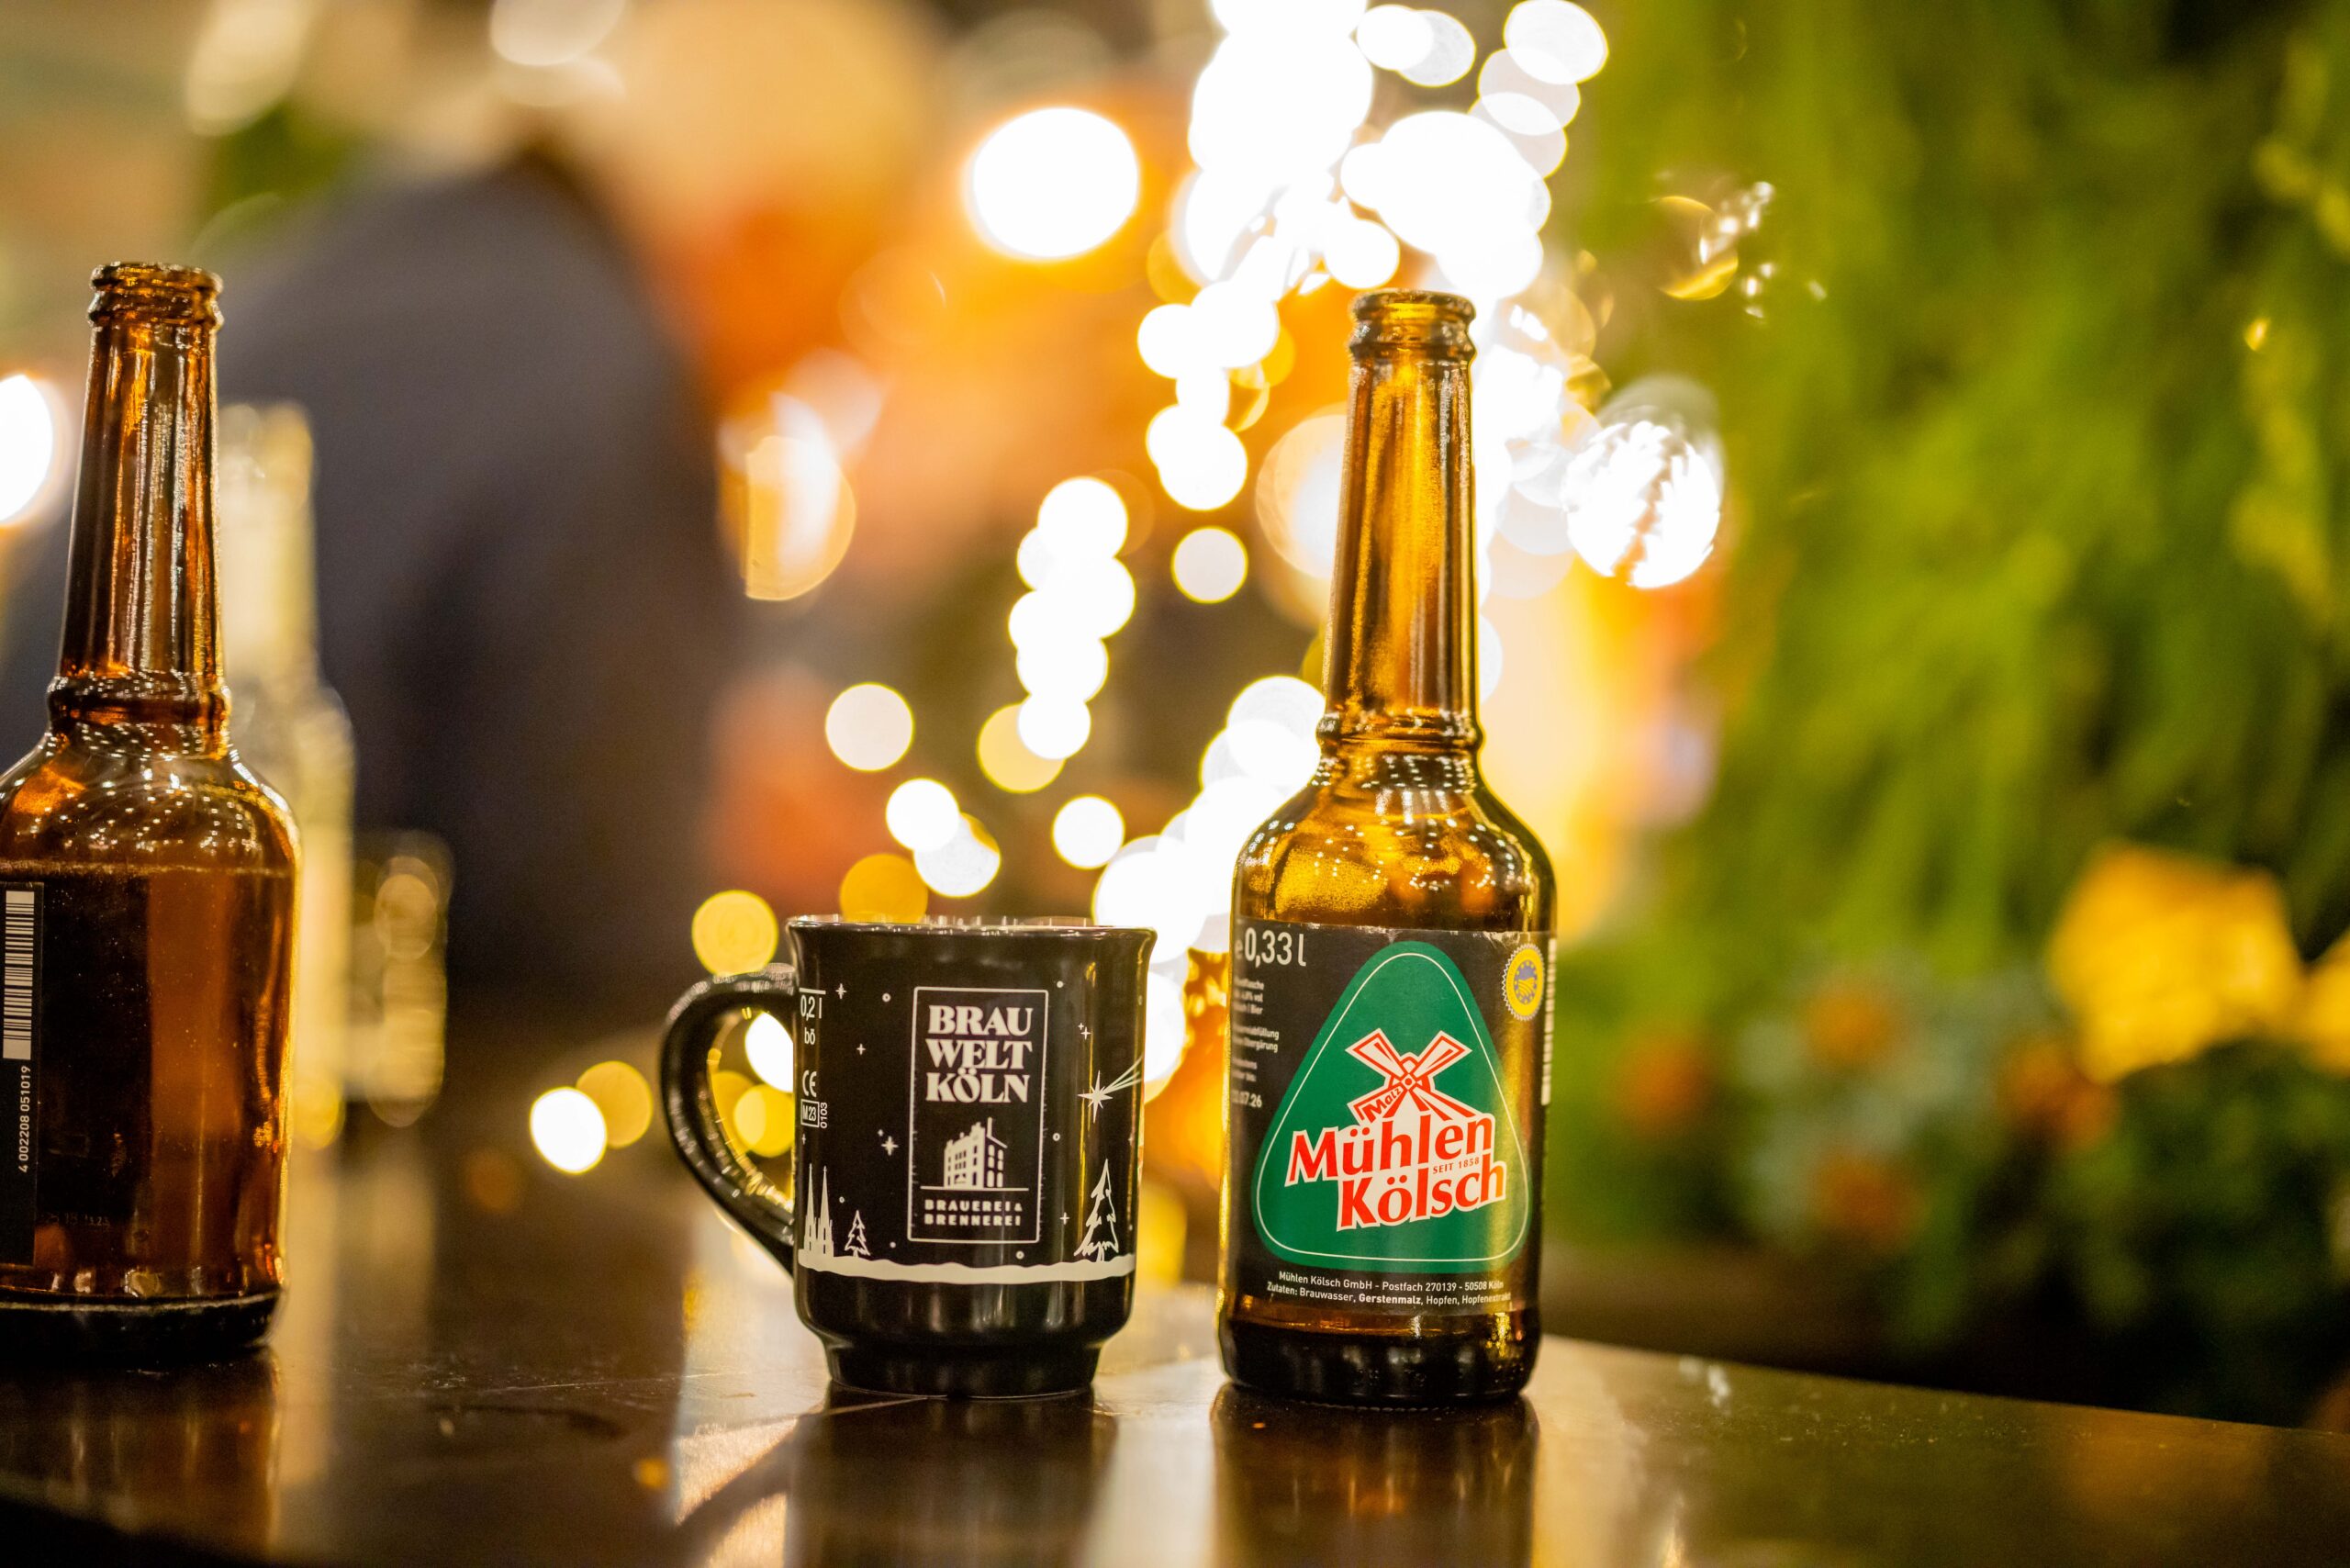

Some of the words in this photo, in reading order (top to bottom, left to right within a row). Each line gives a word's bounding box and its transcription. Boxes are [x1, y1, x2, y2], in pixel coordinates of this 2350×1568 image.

[1244, 926, 1292, 969] 0,33
[1297, 933, 1307, 967] l
[927, 1004, 1034, 1036] BRAU
[924, 1038, 1034, 1070] WELT
[19, 1065, 31, 1112] 051019
[924, 1067, 1031, 1103] KÖLN
[819, 1102, 828, 1129] 0103
[1362, 1087, 1402, 1124] Malz
[18, 1114, 30, 1162] 002208
[1288, 1113, 1494, 1182] Mühlen
[17, 1163, 29, 1173] 4
[1432, 1163, 1453, 1175] SEIT
[1458, 1157, 1481, 1170] 1858
[923, 1199, 1012, 1213] BRAUEREI
[1013, 1203, 1024, 1213] &
[1340, 1153, 1505, 1227] Kölsch
[923, 1213, 1022, 1226] BRENNEREI
[1267, 1282, 1298, 1296] Zutaten:
[1299, 1287, 1357, 1303] Brauwasser,
[1359, 1293, 1424, 1306] Gerstenmalz,
[1426, 1295, 1460, 1307] Hopfen,
[1279, 1271, 1309, 1284] Mühlen
[1310, 1275, 1341, 1288] Kölsch
[1343, 1279, 1373, 1290] GmbH
[1382, 1281, 1423, 1292] Postfach
[1426, 1282, 1457, 1292] 270139
[1464, 1281, 1487, 1291] 50508
